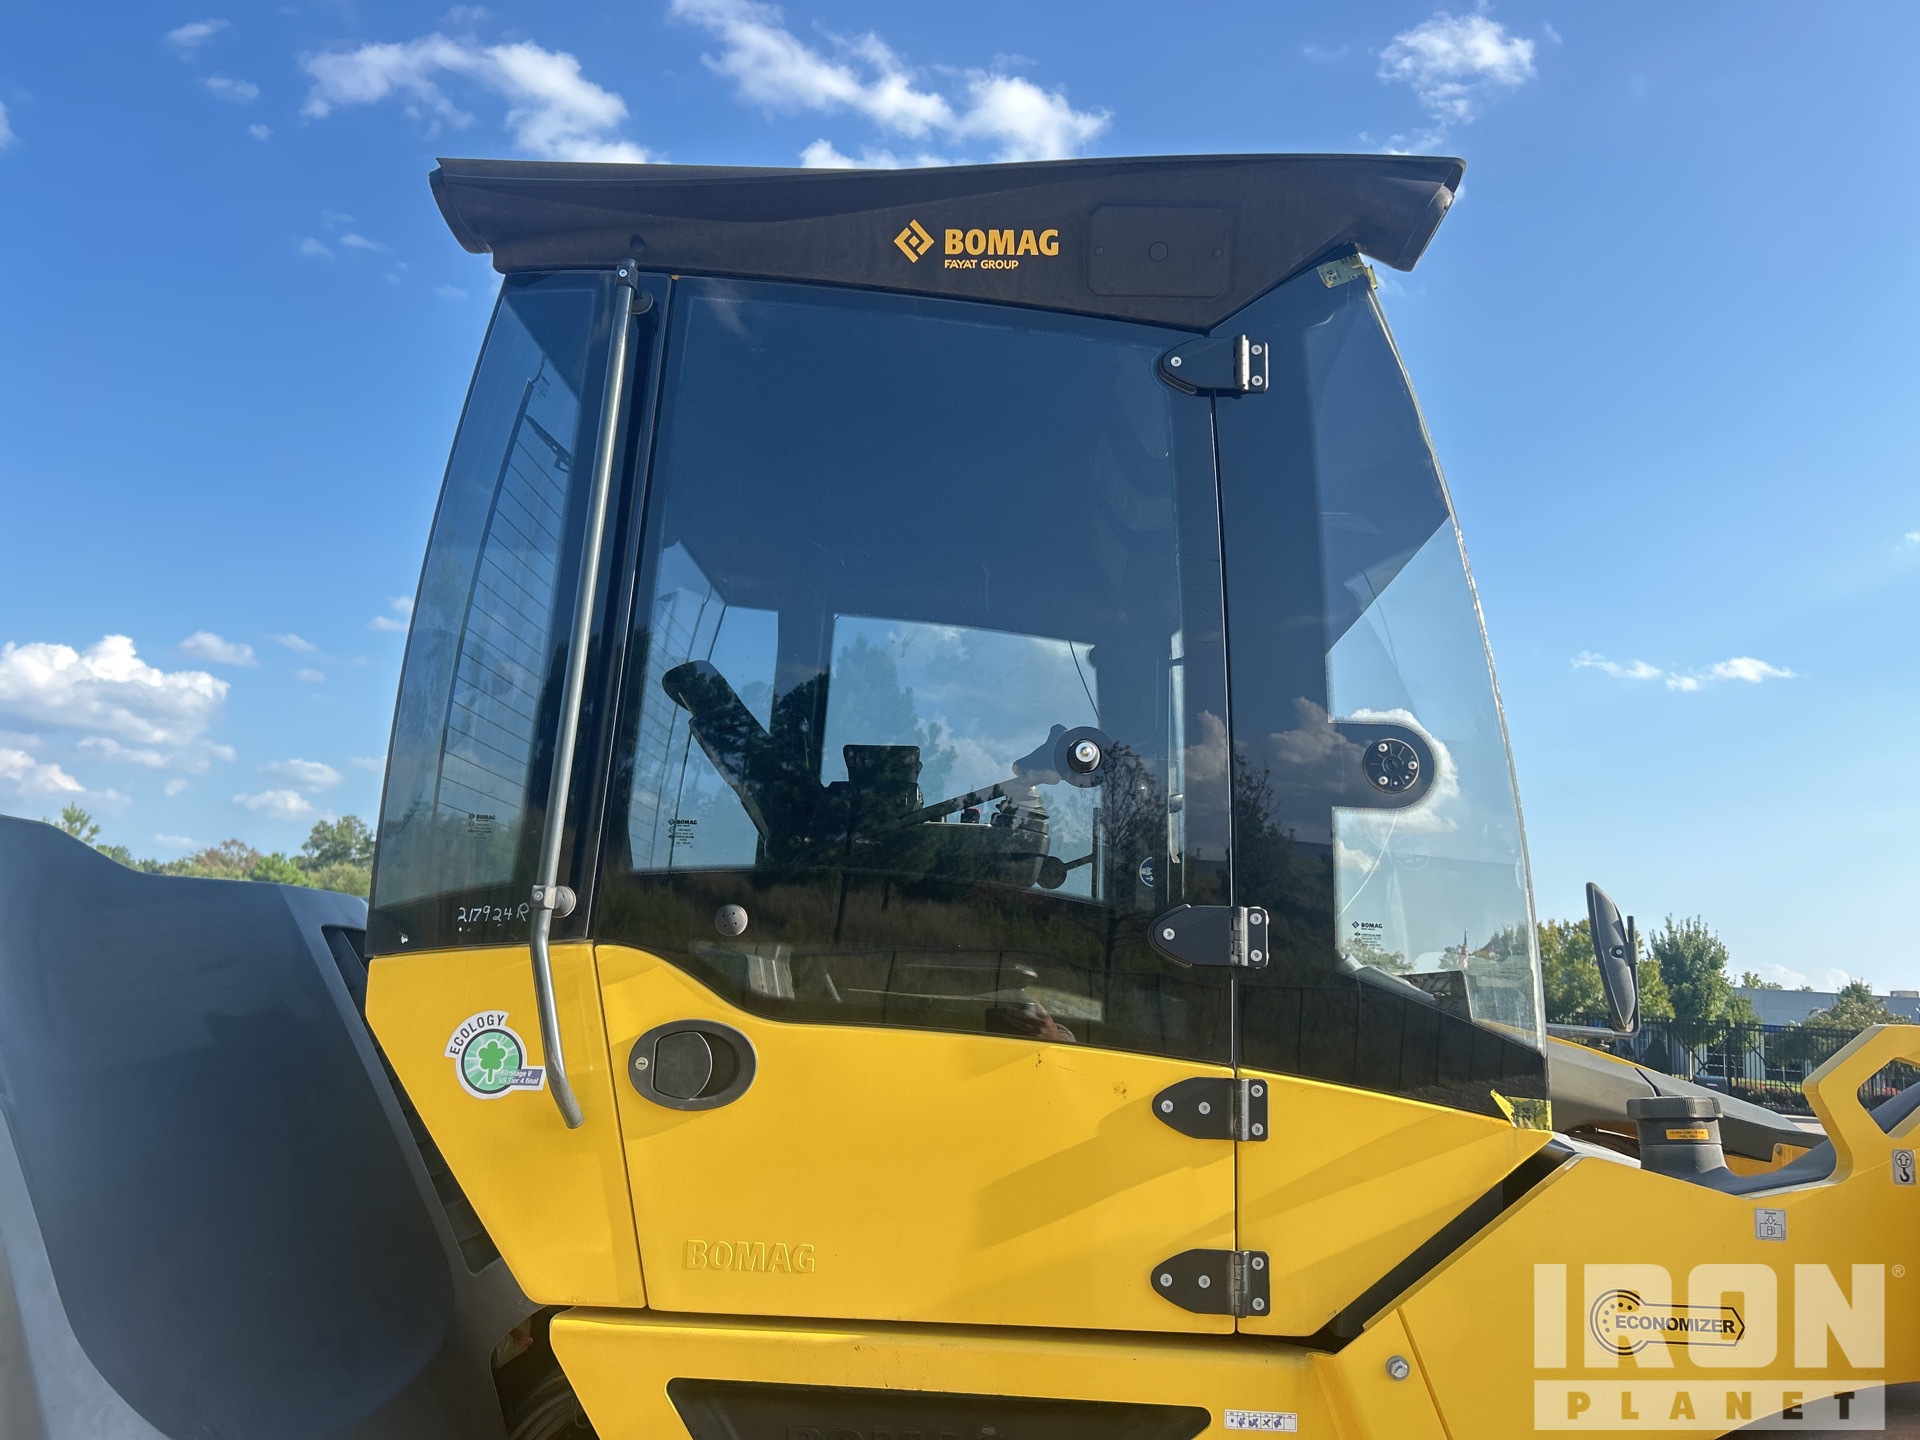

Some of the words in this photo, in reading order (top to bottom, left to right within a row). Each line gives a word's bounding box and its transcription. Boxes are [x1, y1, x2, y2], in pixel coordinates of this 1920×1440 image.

[944, 228, 1060, 256] BOMAG
[944, 259, 978, 269] FAYAT
[980, 259, 1019, 270] GROUP
[449, 1014, 504, 1055] ECOLOGY
[510, 1069, 527, 1078] Stage
[525, 1077, 539, 1085] final
[682, 1239, 815, 1274] BOMAG
[1615, 1314, 1737, 1334] ECONOMIZER
